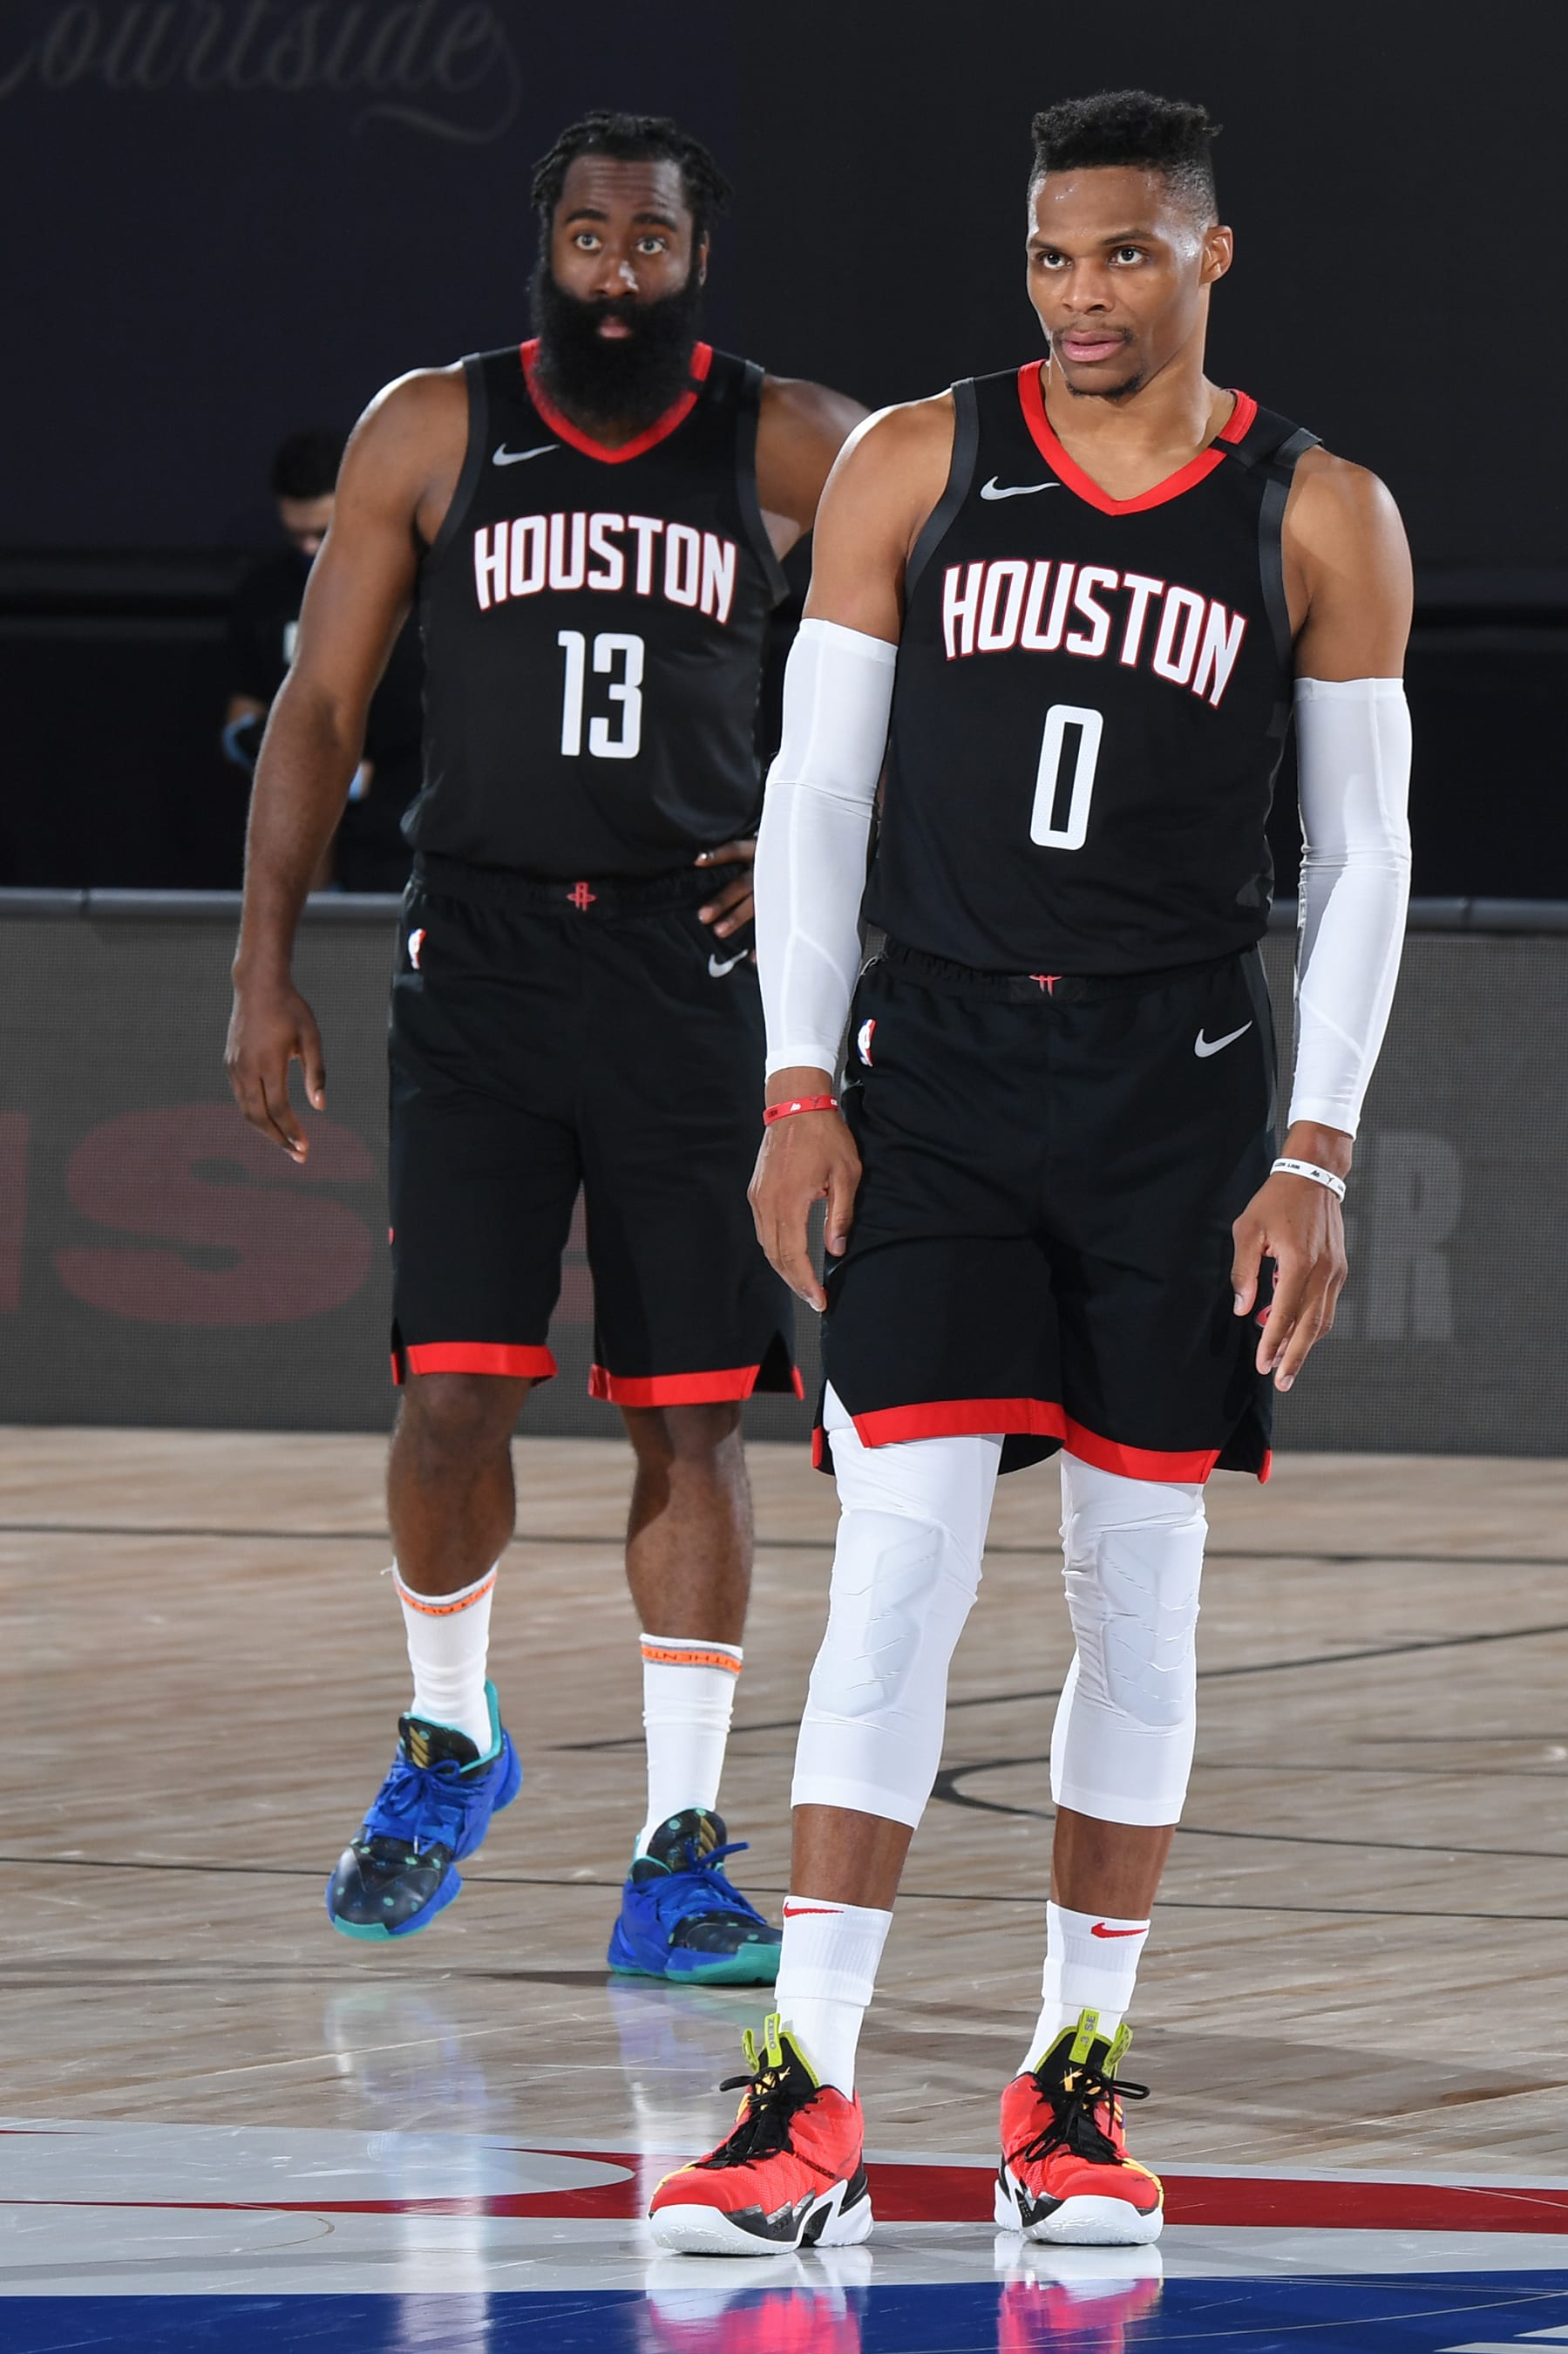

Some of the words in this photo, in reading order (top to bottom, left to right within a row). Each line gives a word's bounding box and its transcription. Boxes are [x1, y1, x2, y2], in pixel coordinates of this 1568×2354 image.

[0, 0, 521, 144] ourtside
[473, 511, 737, 626] HOUSTON
[942, 558, 1248, 709] HOUSTON
[557, 629, 645, 759] 13
[1029, 704, 1103, 851] 0
